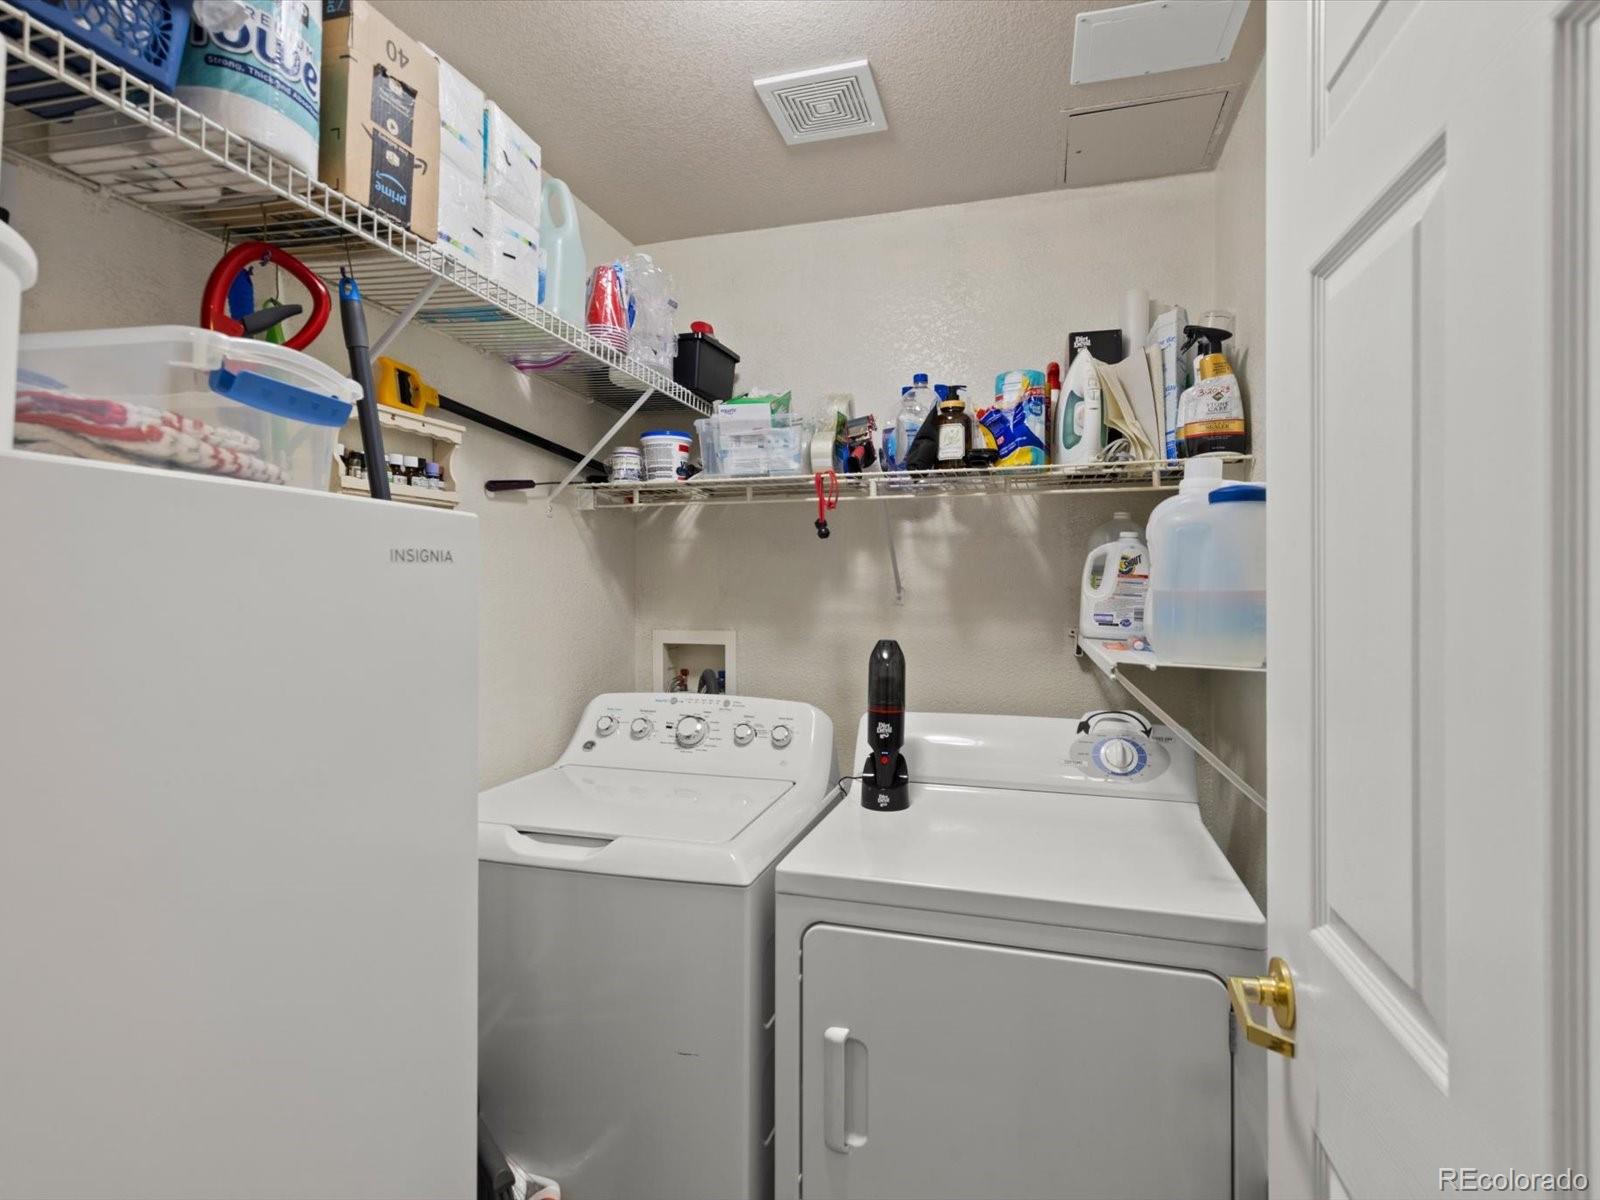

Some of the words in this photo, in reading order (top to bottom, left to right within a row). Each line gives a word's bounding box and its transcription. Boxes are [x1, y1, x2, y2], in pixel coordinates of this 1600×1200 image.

[385, 39, 410, 71] 40
[374, 180, 407, 206] prime
[389, 549, 454, 563] INSIGNIA
